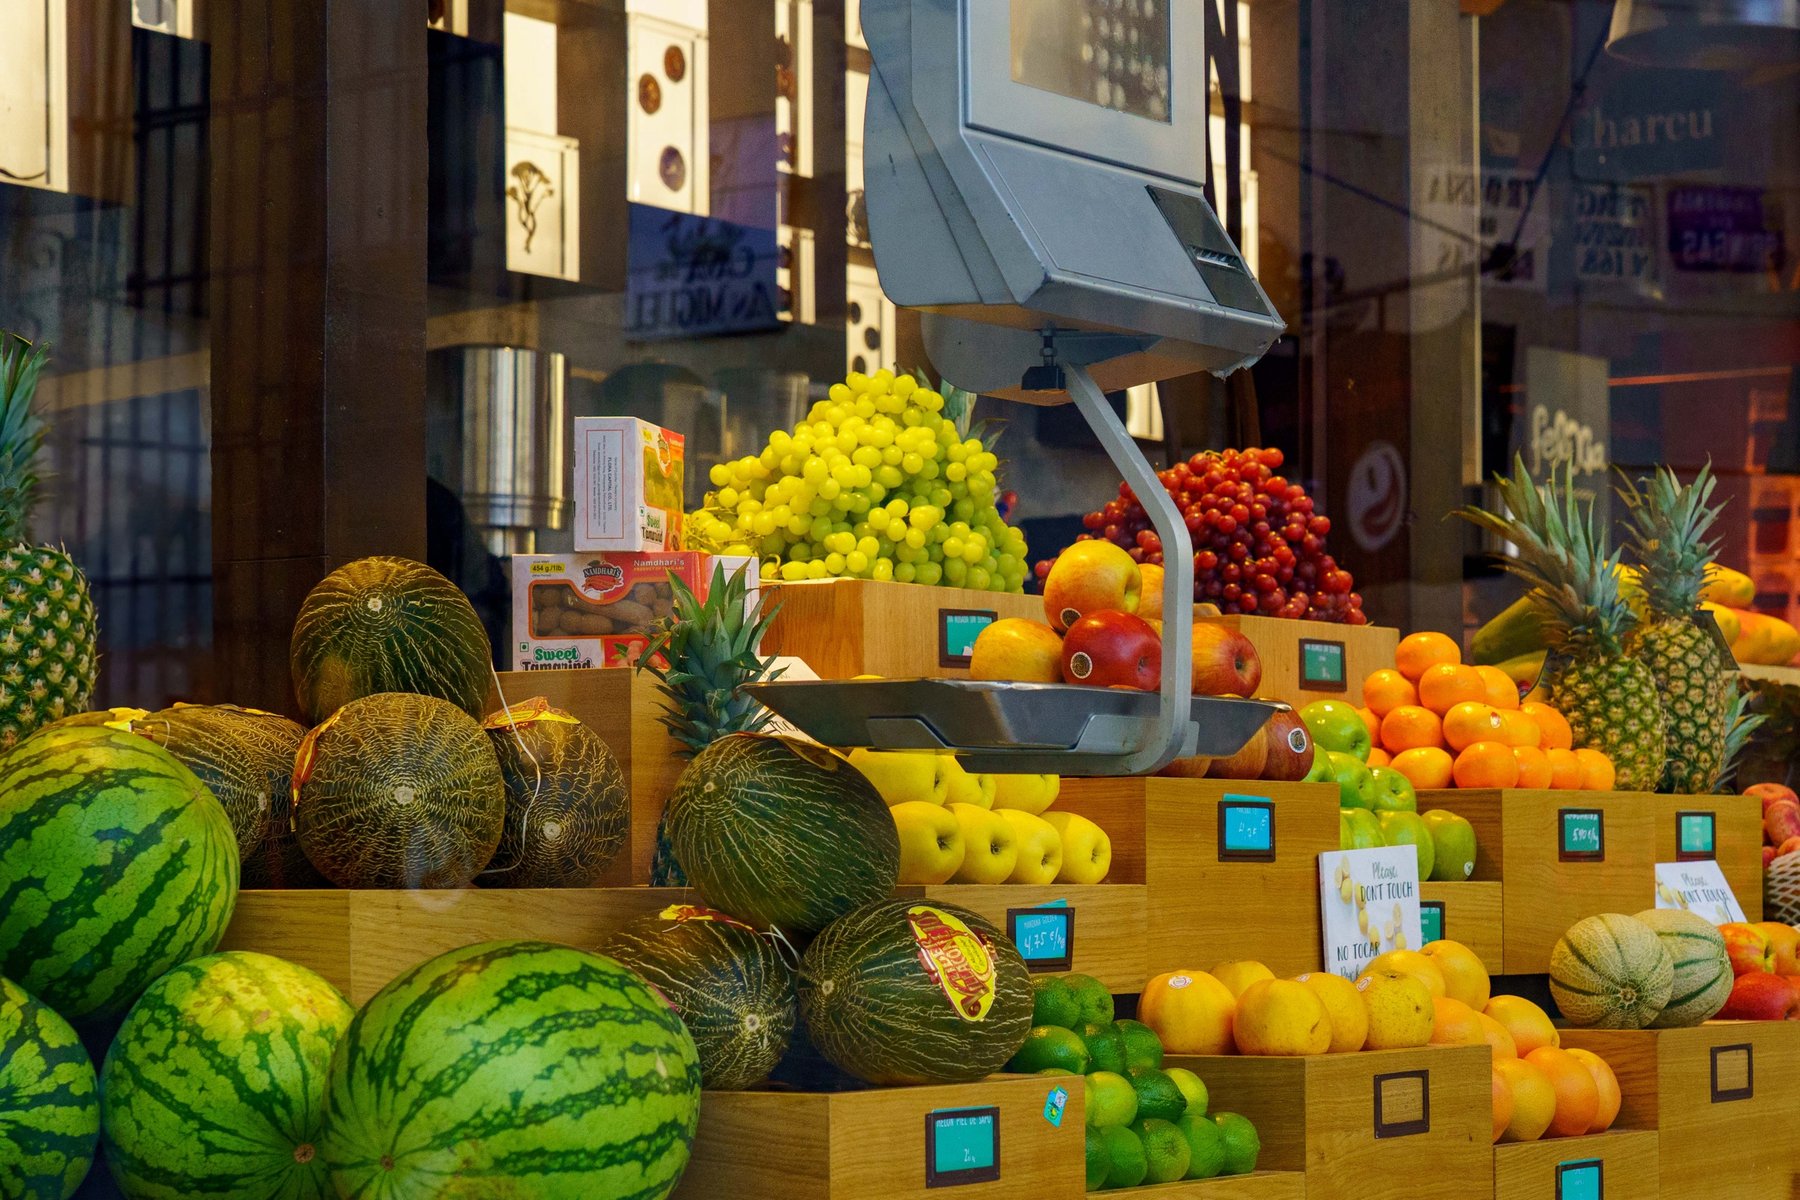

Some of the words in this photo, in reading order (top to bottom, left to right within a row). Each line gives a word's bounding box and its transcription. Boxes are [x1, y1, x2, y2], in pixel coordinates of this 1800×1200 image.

[535, 647, 579, 661] Sweet
[1387, 881, 1413, 899] TOUCH
[1336, 946, 1349, 962] NO
[1353, 941, 1381, 959] TOCAR
